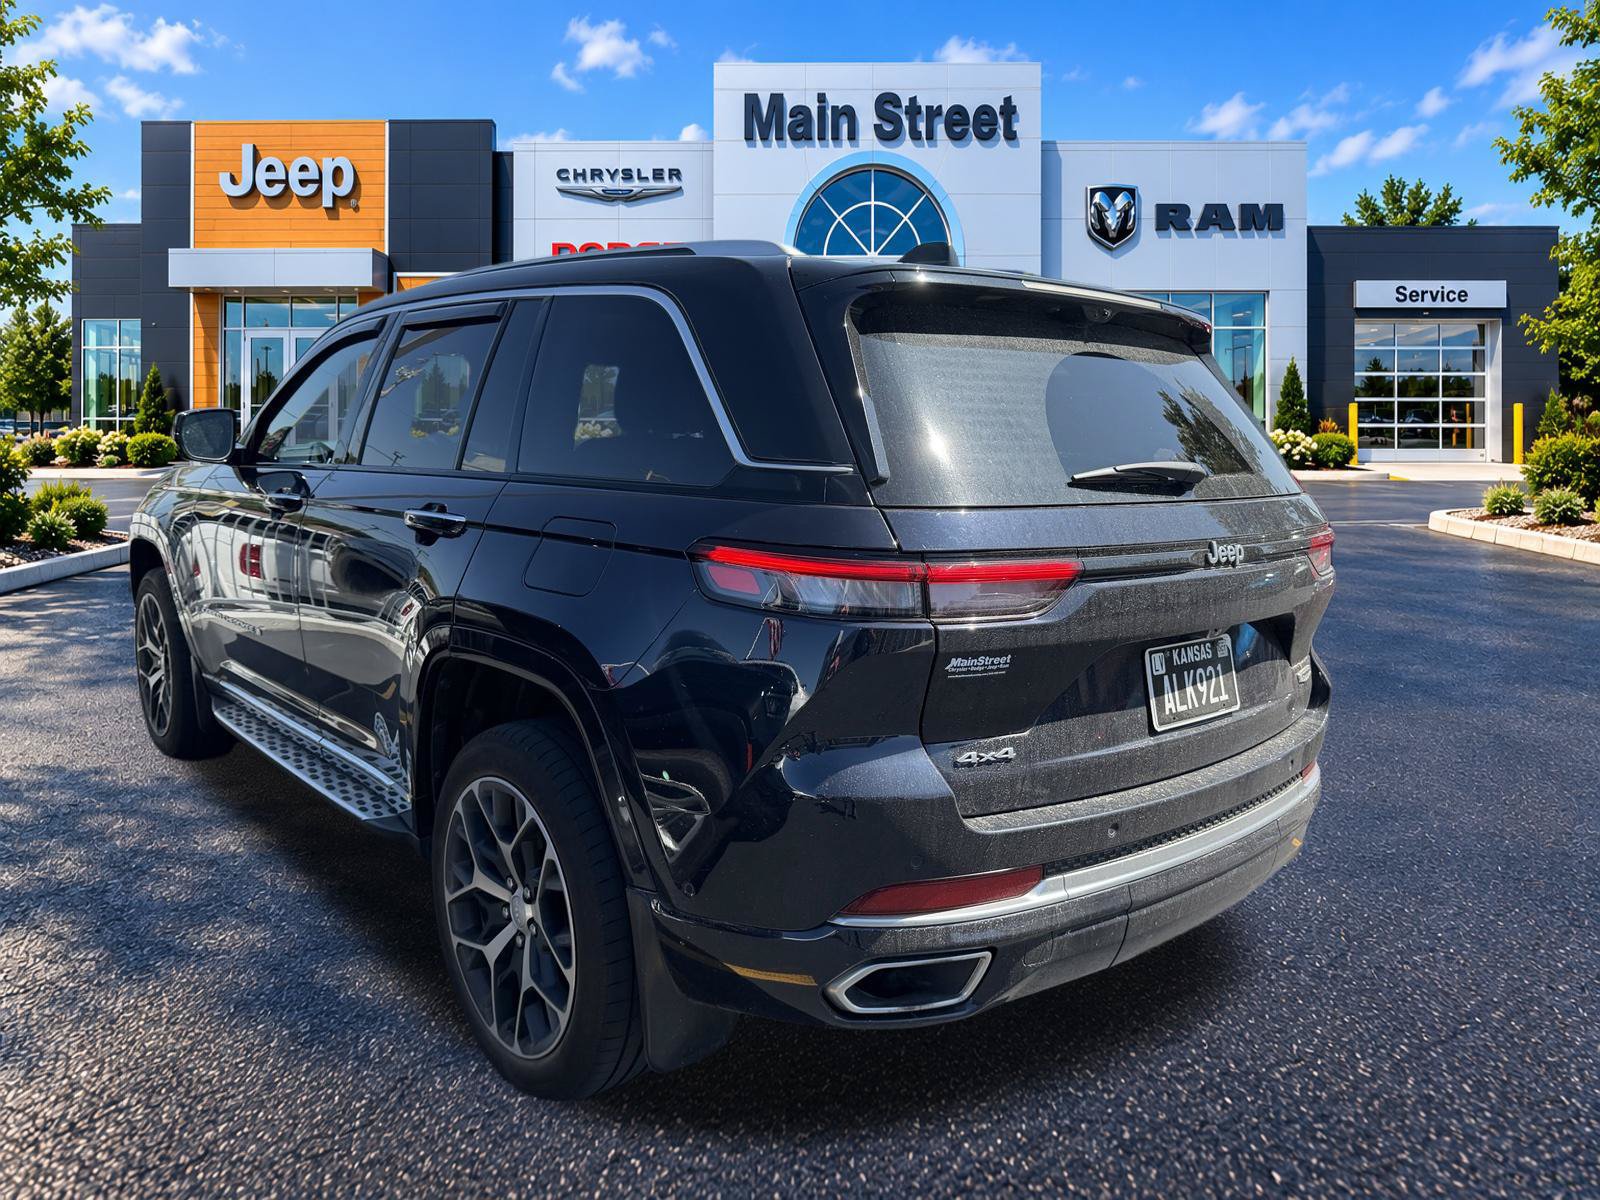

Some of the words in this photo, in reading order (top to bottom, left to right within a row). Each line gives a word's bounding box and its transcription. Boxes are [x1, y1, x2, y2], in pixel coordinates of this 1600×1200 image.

[744, 93, 858, 141] Main
[873, 91, 1018, 141] Street
[218, 143, 355, 208] Jeep
[555, 167, 683, 182] CHRYSLER
[1154, 203, 1284, 232] RAM
[1395, 284, 1469, 303] Service
[1208, 540, 1245, 567] Jeep
[945, 654, 1012, 670] MainStreet
[1171, 642, 1212, 666] KANSAS
[1163, 663, 1230, 715] ALK921
